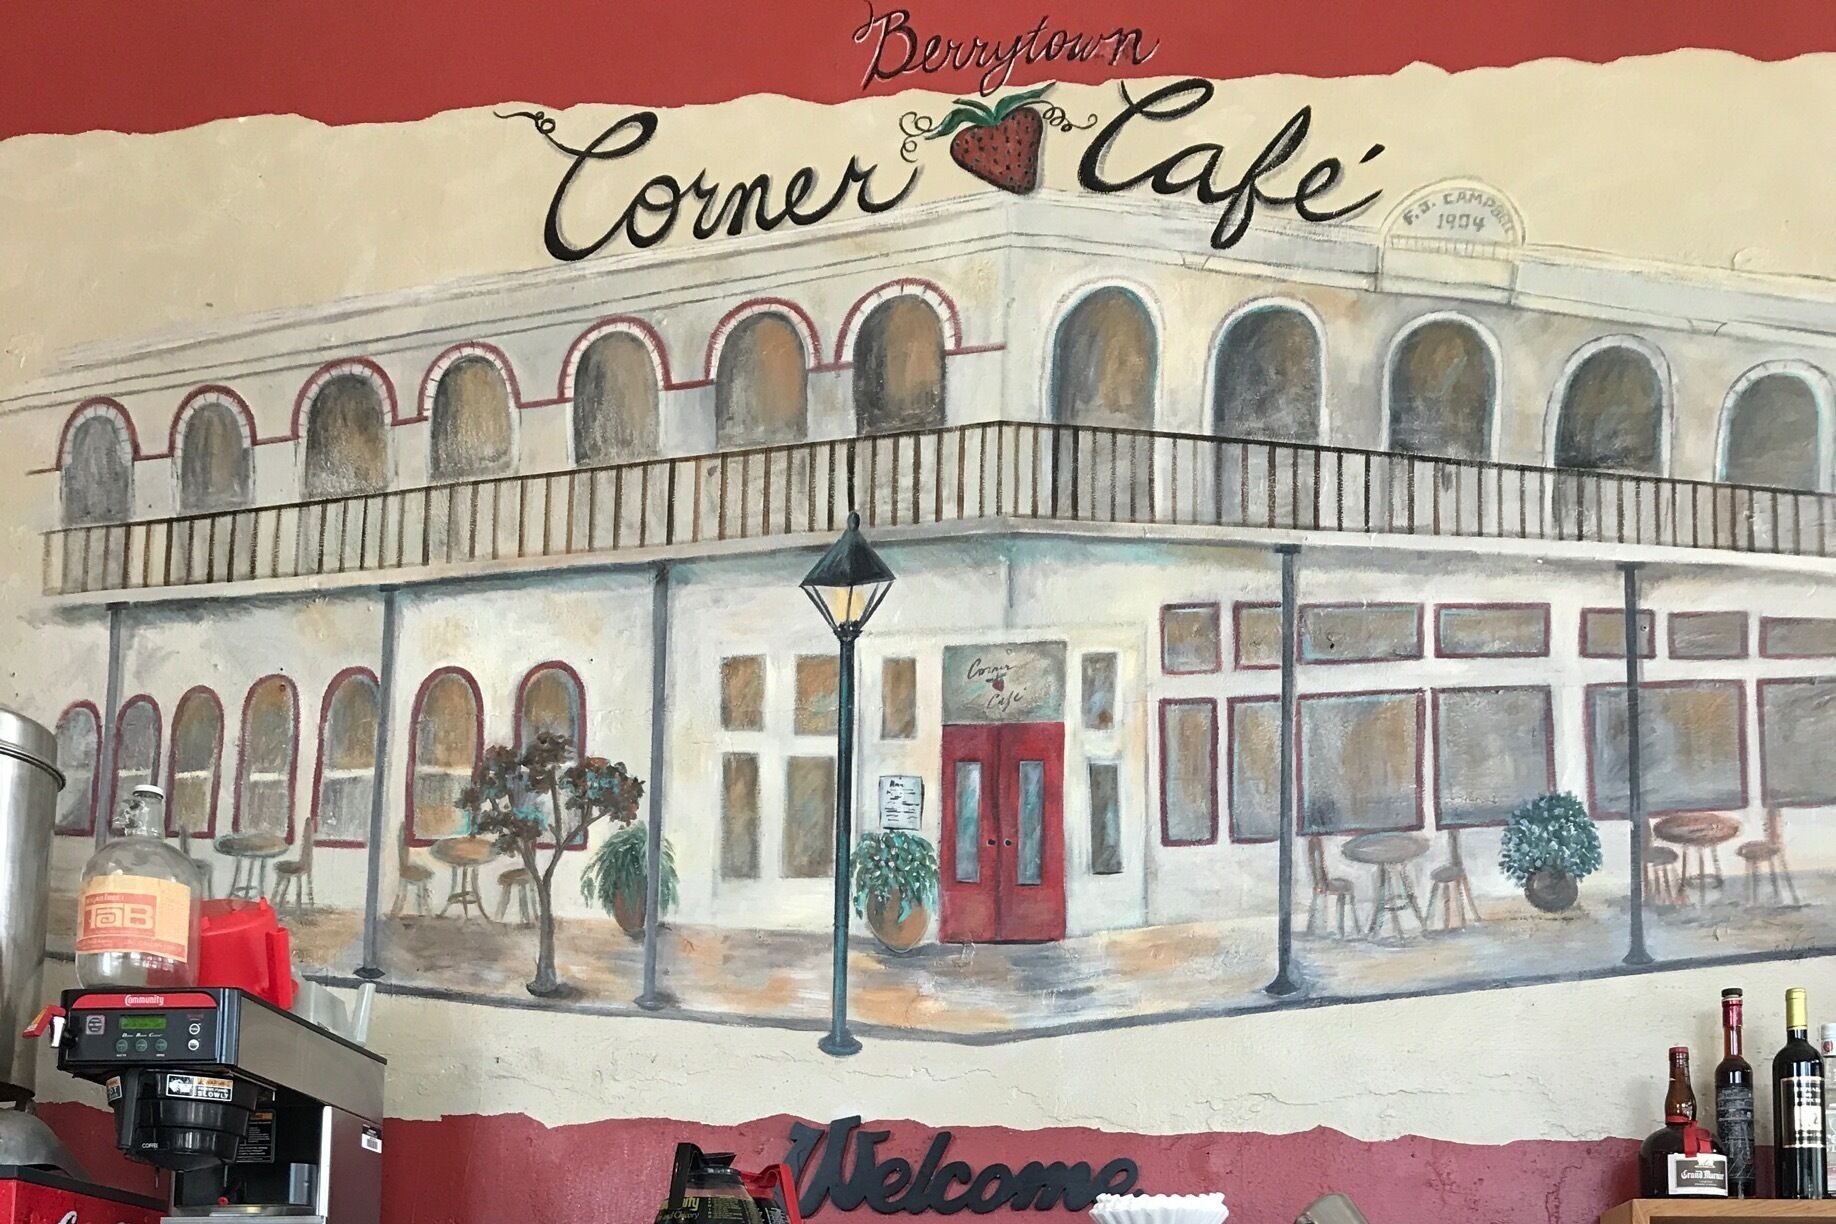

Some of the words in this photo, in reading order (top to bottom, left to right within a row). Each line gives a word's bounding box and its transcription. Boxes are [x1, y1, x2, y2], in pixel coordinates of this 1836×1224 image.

[855, 2, 1158, 96] Berrytown
[498, 110, 918, 261] Corner
[1078, 78, 1385, 250] Café
[124, 994, 165, 1007] Community
[783, 1115, 1144, 1218] Welcome
